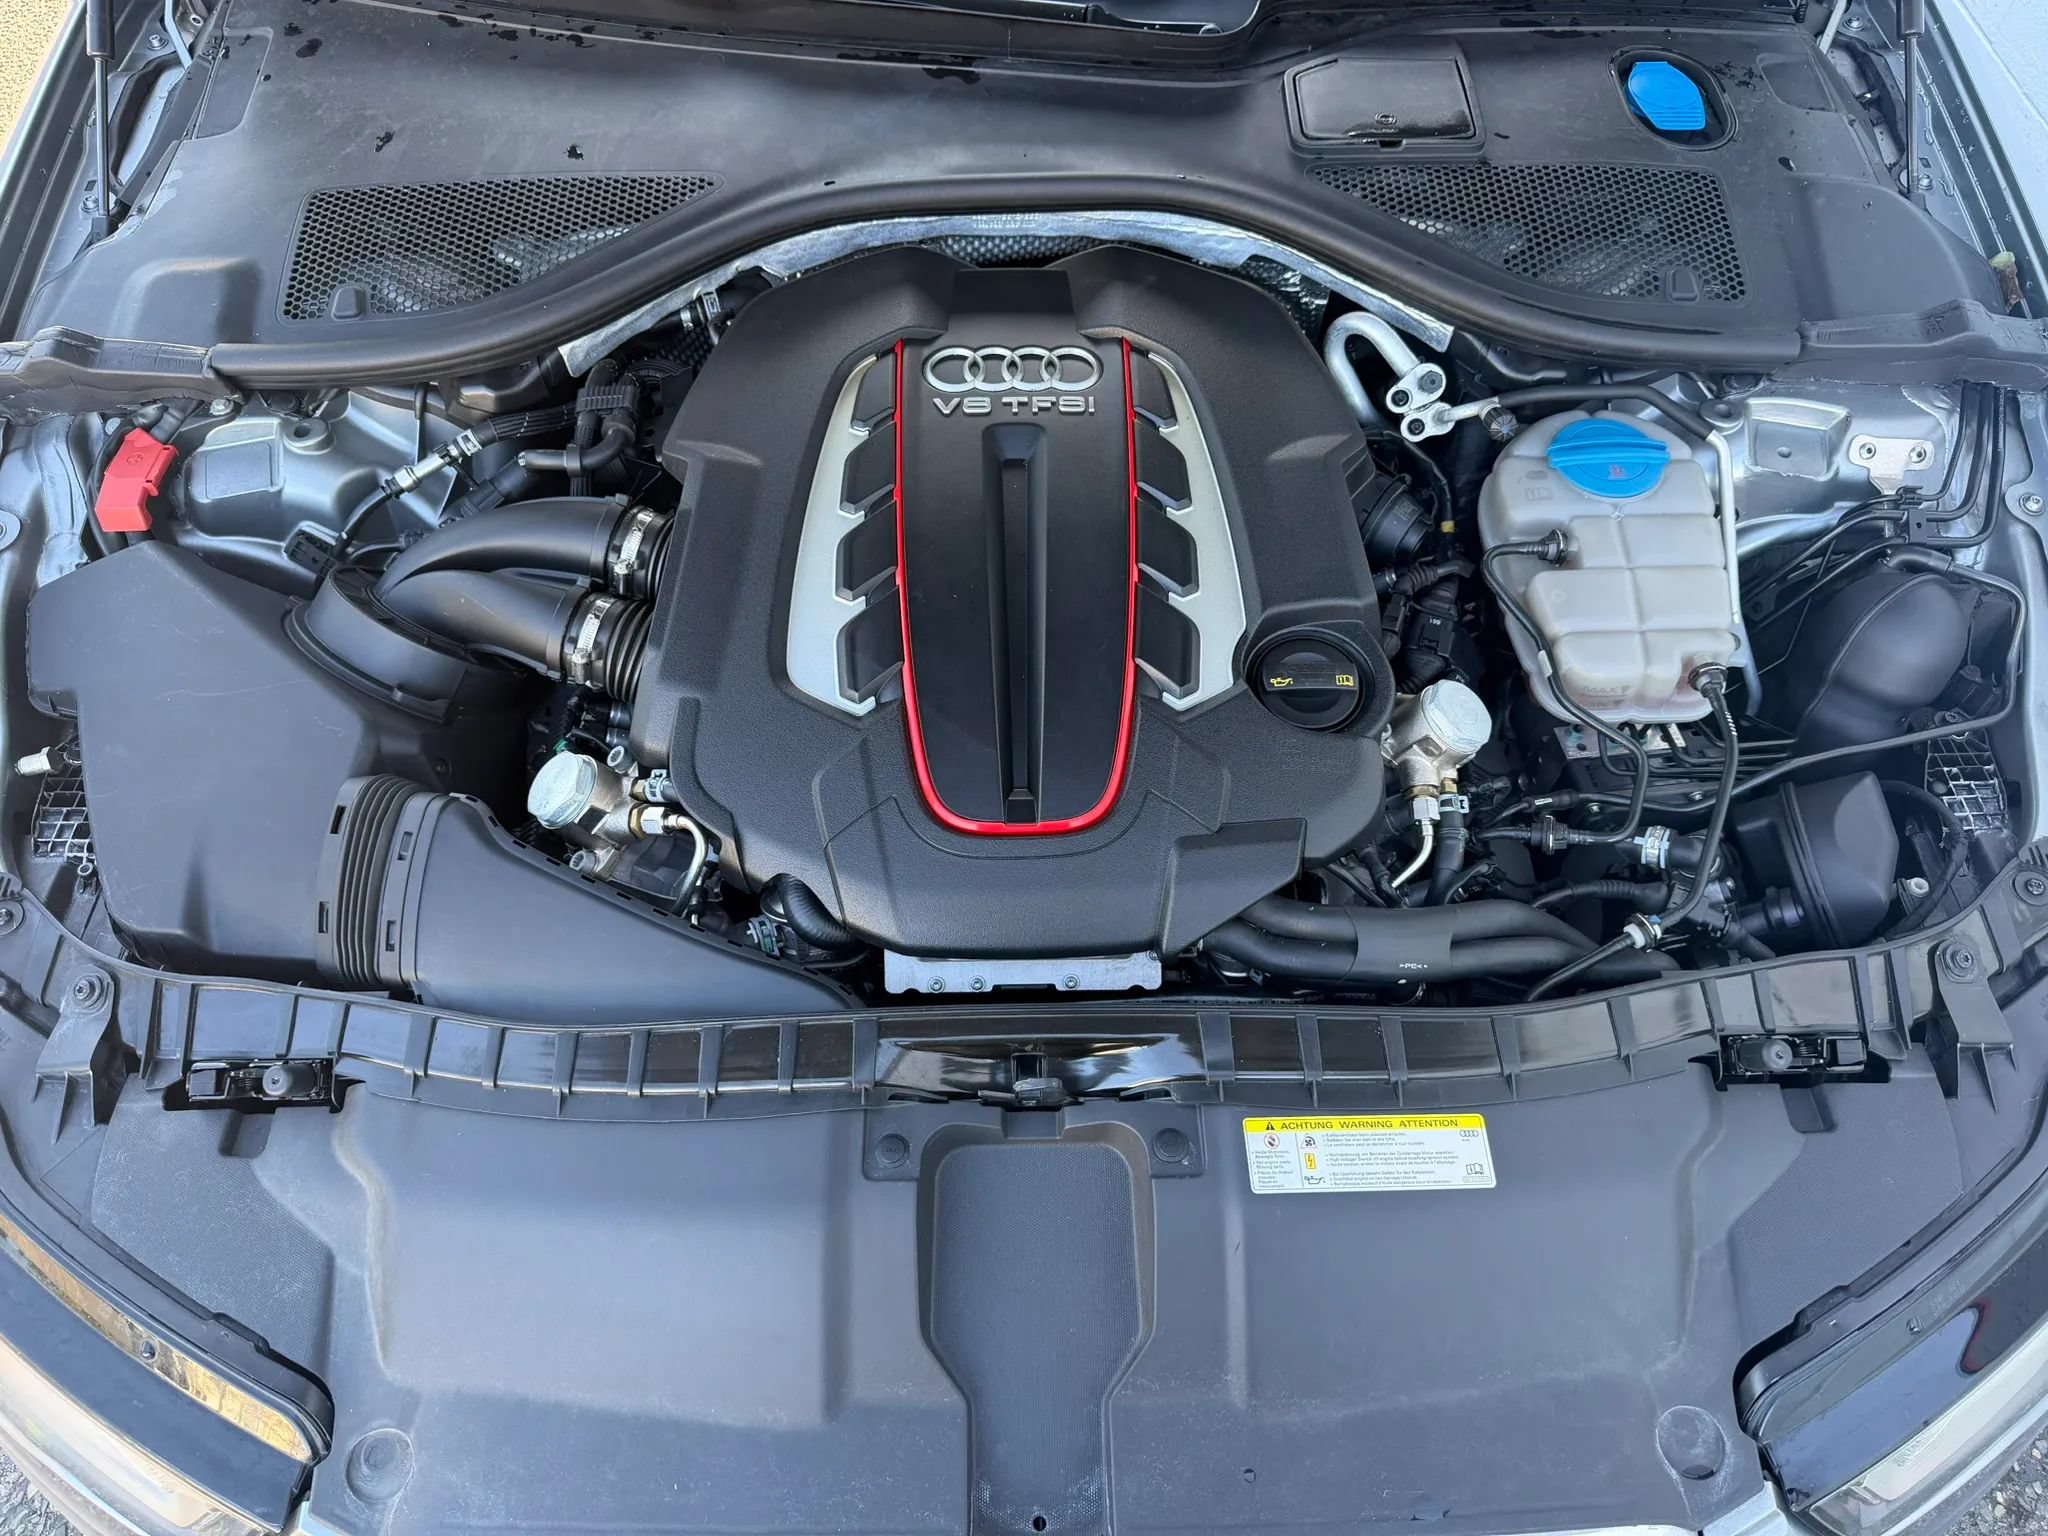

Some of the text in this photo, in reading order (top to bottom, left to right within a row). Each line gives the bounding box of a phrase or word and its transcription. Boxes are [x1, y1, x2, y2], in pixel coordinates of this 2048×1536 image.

[932, 396, 1096, 415] V8 TFSI
[1280, 1119, 1459, 1130] ACHTUNG WARNING ATTENTION
